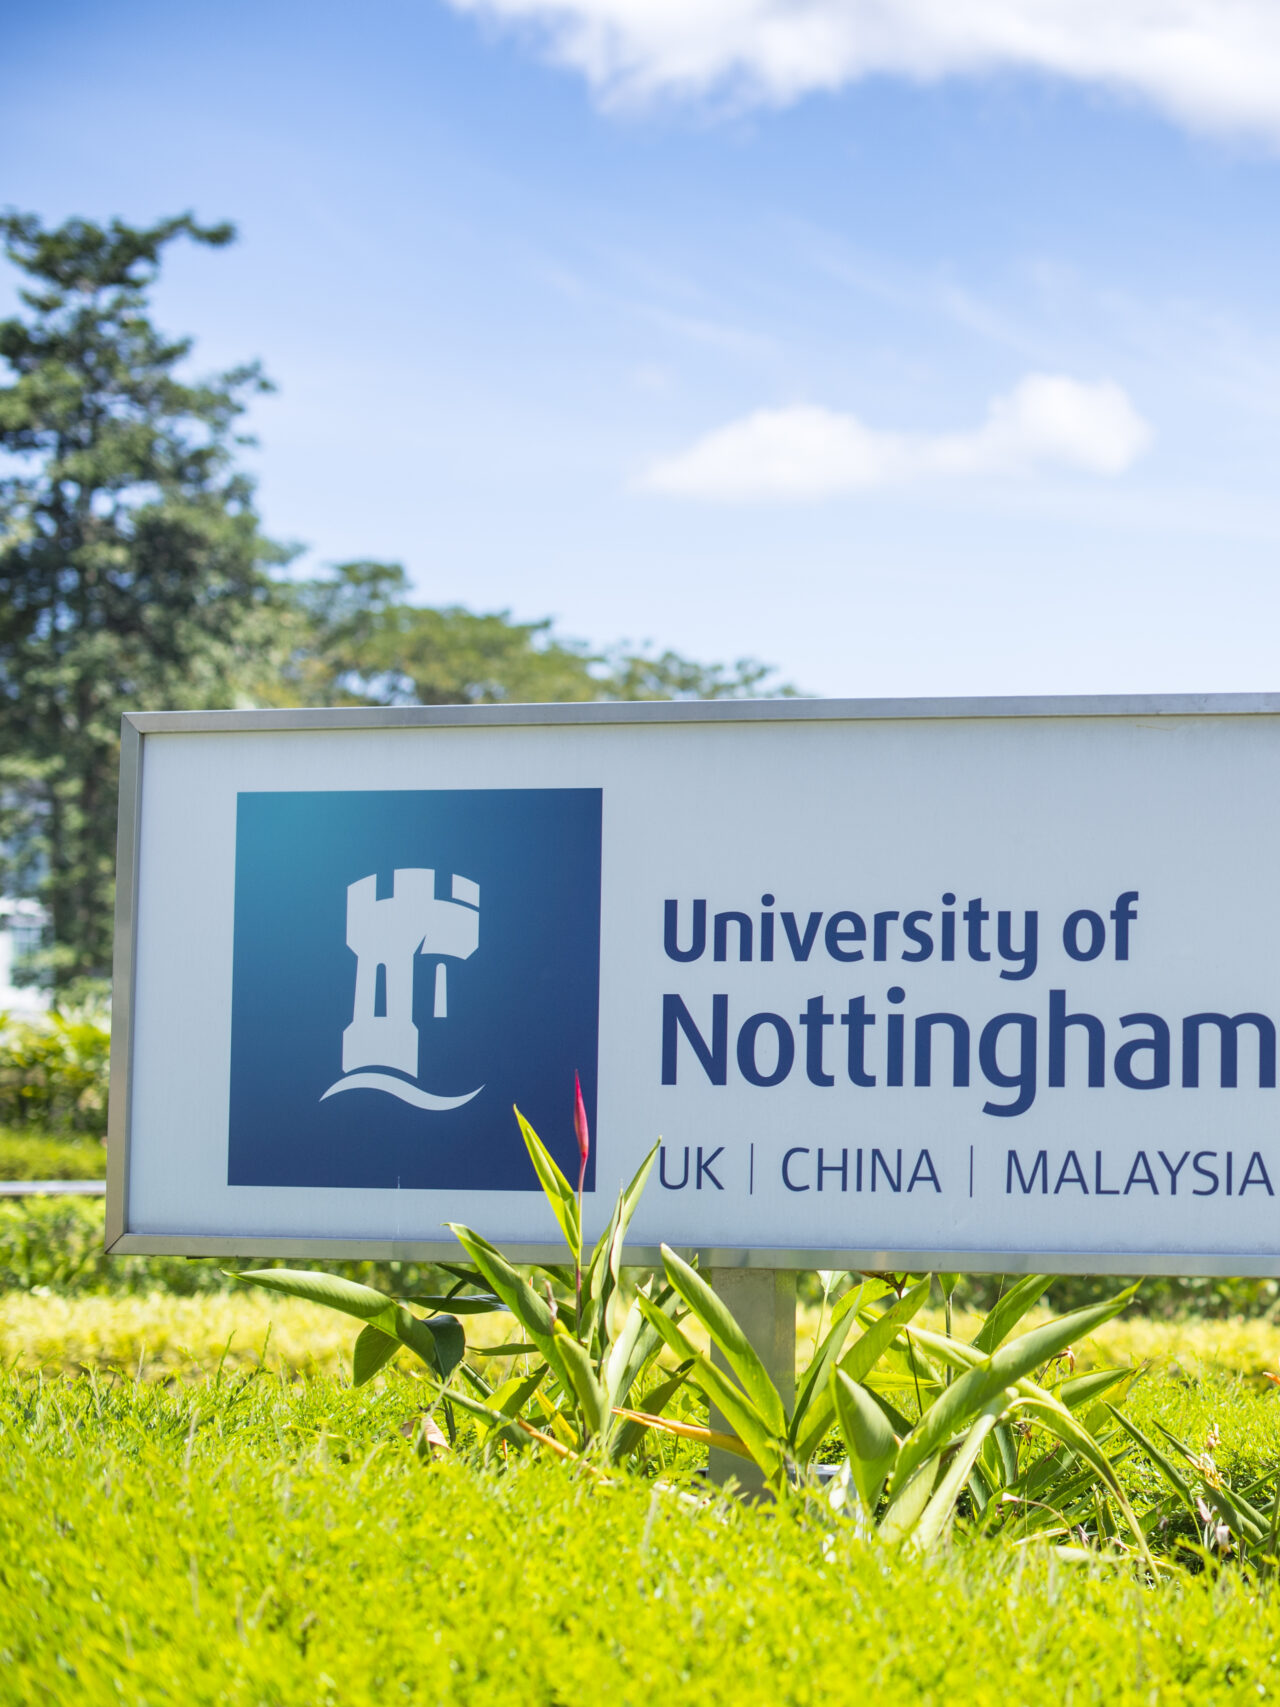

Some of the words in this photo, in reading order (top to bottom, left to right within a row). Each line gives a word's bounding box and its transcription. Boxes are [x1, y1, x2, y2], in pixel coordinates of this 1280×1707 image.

[663, 893, 1038, 981] University
[1063, 890, 1139, 962] of
[661, 986, 1277, 1118] Nottingham
[659, 1145, 726, 1191] UK
[781, 1147, 942, 1193] CHINA
[1006, 1149, 1275, 1197] MALAYSIA
